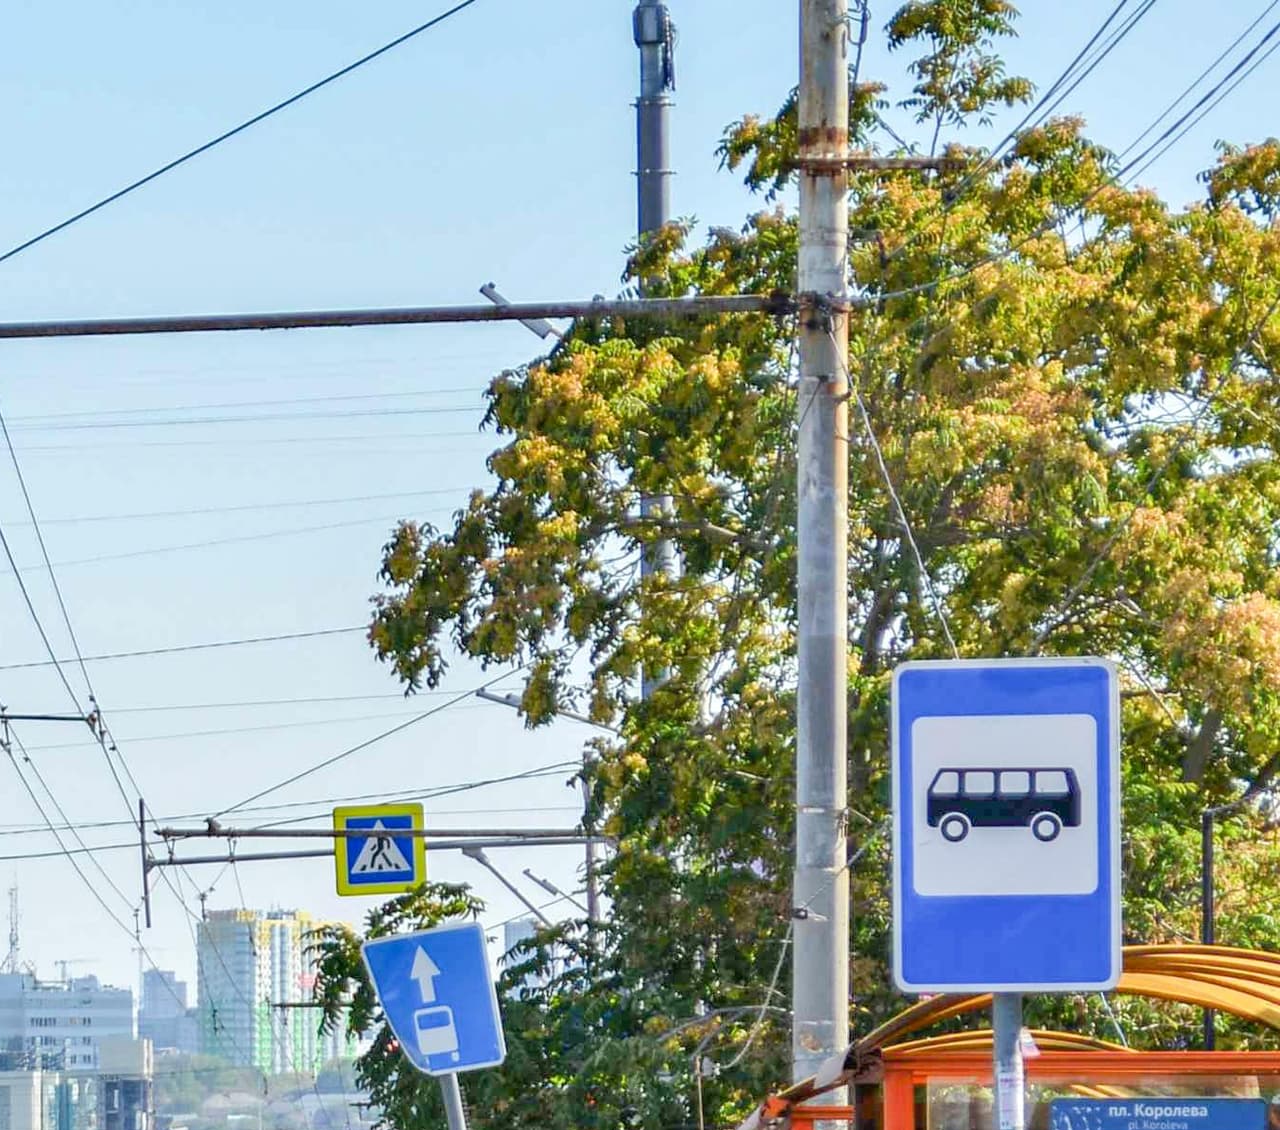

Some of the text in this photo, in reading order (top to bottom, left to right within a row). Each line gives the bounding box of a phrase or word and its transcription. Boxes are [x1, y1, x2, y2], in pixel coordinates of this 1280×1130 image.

[1108, 1103, 1209, 1120] пл. Королева
[1142, 1119, 1189, 1130] Koroleva
